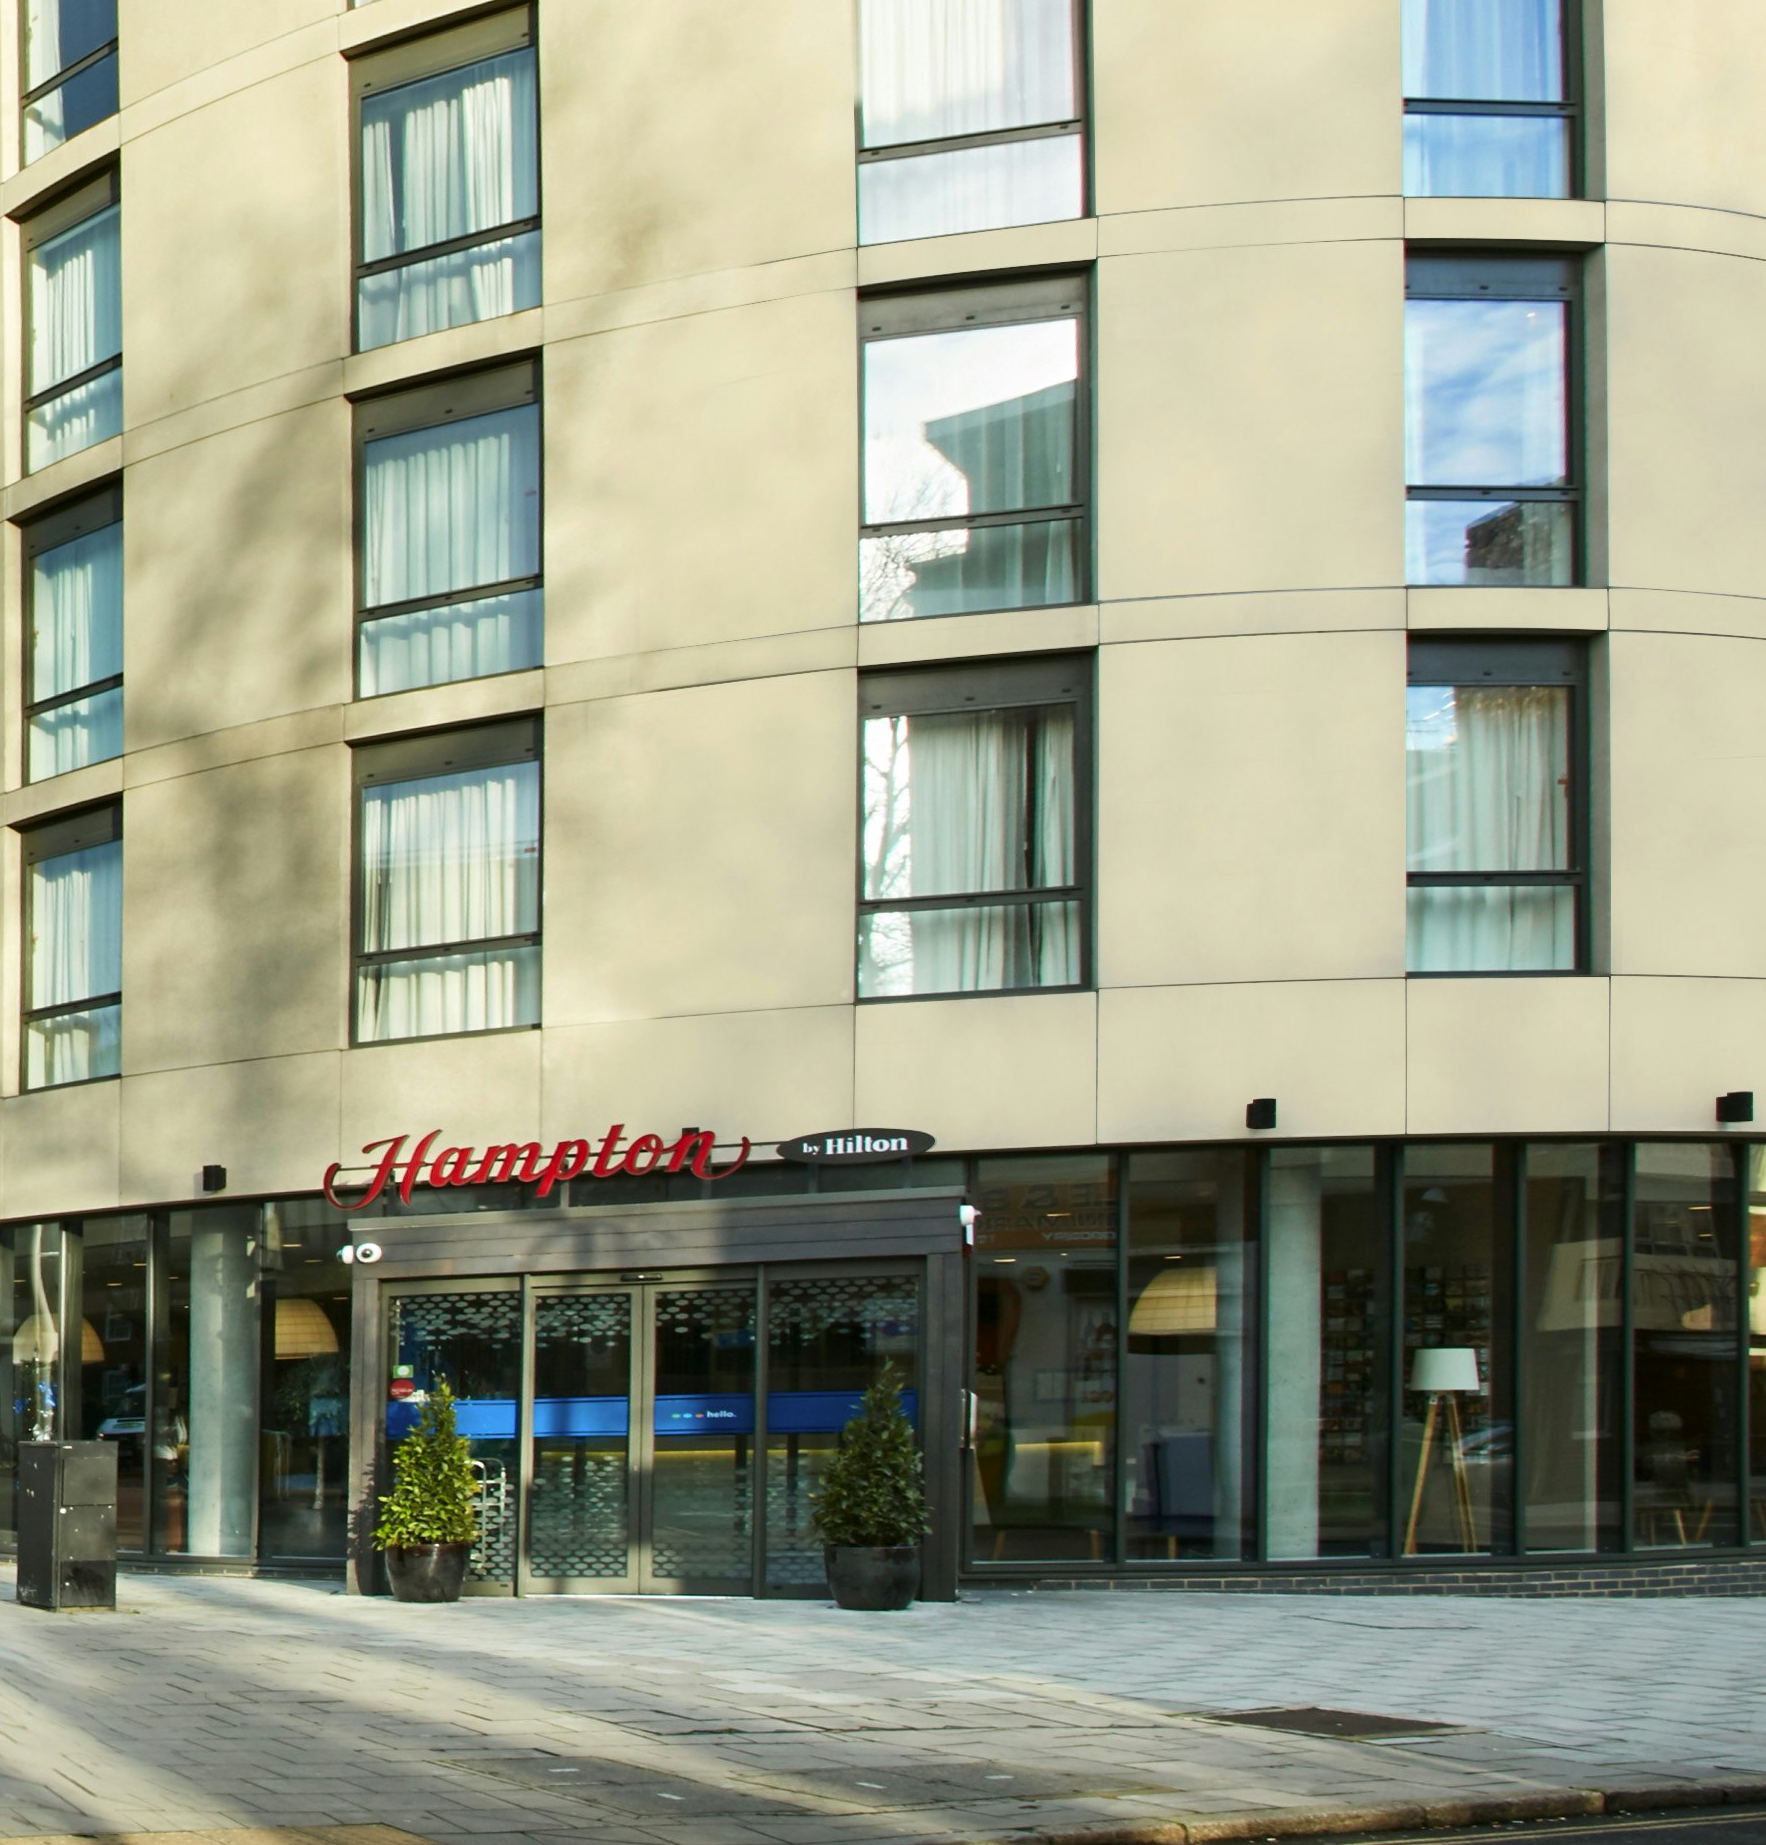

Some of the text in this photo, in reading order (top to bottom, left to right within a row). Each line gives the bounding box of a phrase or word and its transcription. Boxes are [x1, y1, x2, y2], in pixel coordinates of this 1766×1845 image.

[323, 1123, 908, 1210] Hampton by Hilton
